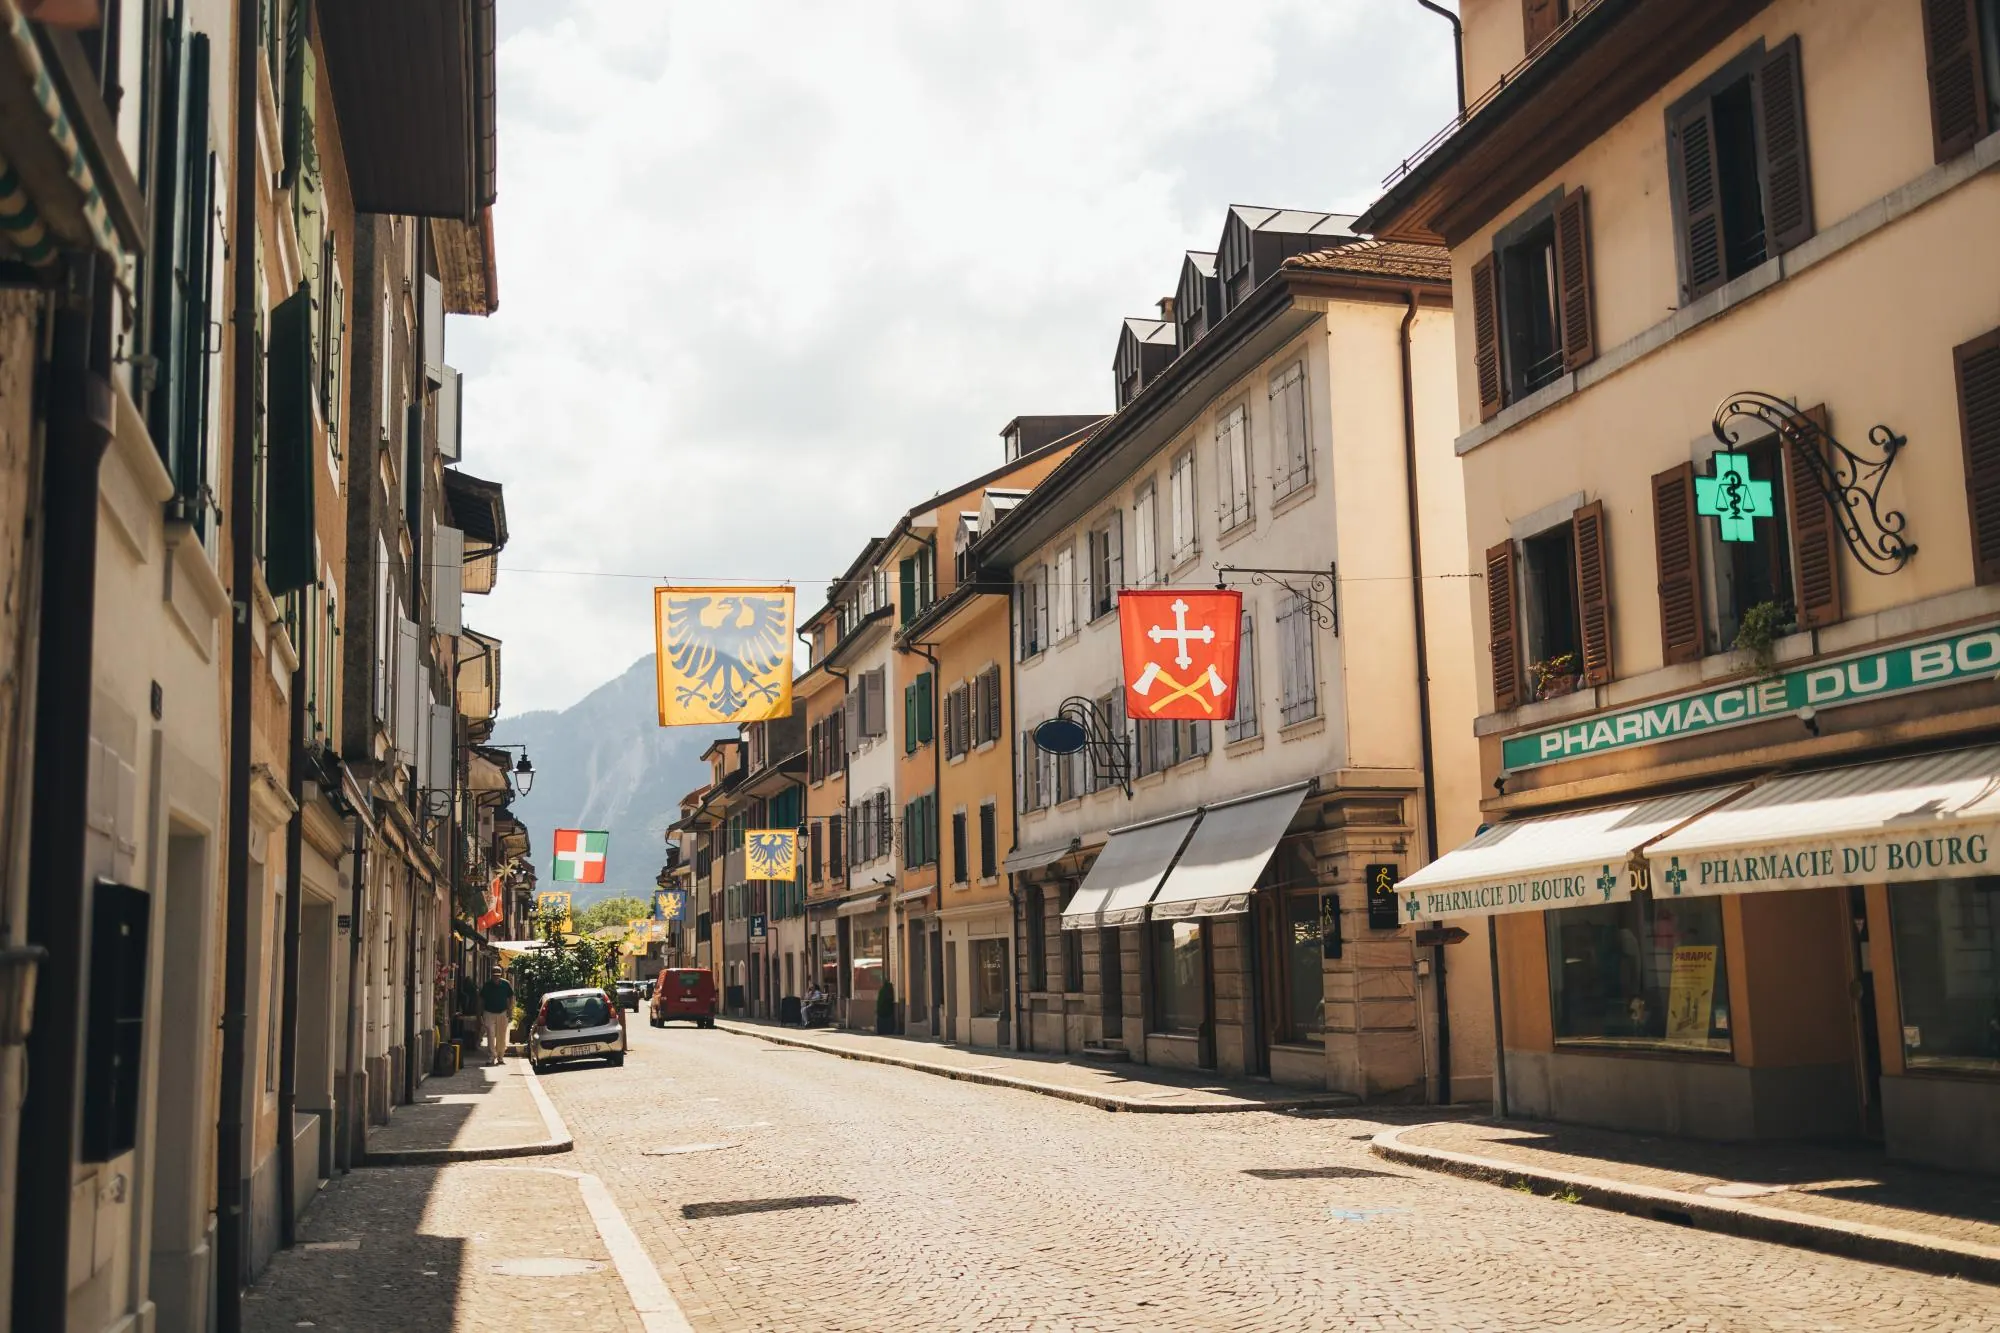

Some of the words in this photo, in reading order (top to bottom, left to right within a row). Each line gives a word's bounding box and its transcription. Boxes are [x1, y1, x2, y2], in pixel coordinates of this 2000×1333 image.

[1540, 679, 1788, 759] PHARMACIE
[1806, 656, 1888, 703] DU
[1700, 850, 1834, 885] PHARMACIE
[1843, 845, 1878, 874] DU
[1887, 834, 1988, 871] BOURG
[1427, 886, 1503, 914] PHARMACIE
[1508, 882, 1527, 904] DU
[1532, 875, 1586, 902] BOURG
